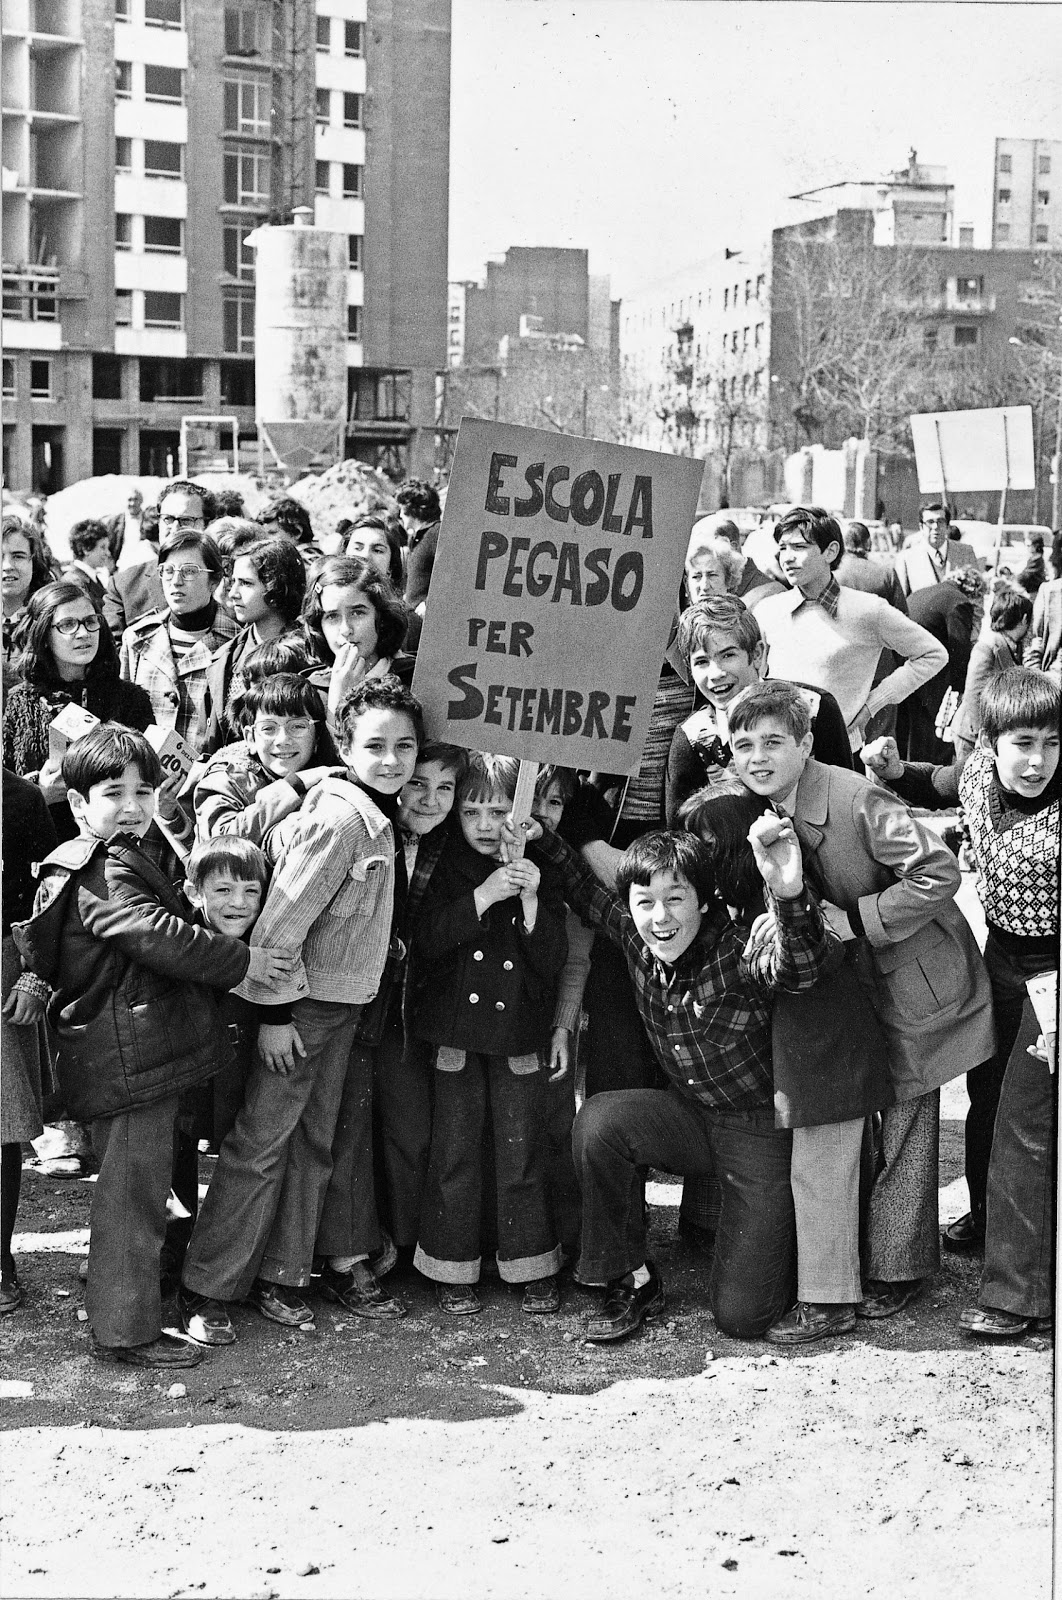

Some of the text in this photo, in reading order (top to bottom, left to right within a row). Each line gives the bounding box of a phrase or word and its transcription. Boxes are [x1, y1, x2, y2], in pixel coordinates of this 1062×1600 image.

[484, 452, 653, 538] ESCOLA
[475, 531, 644, 612] PEGASO
[467, 618, 534, 657] PER
[447, 663, 637, 742] SETEMBRE
[176, 742, 184, 750] 6
